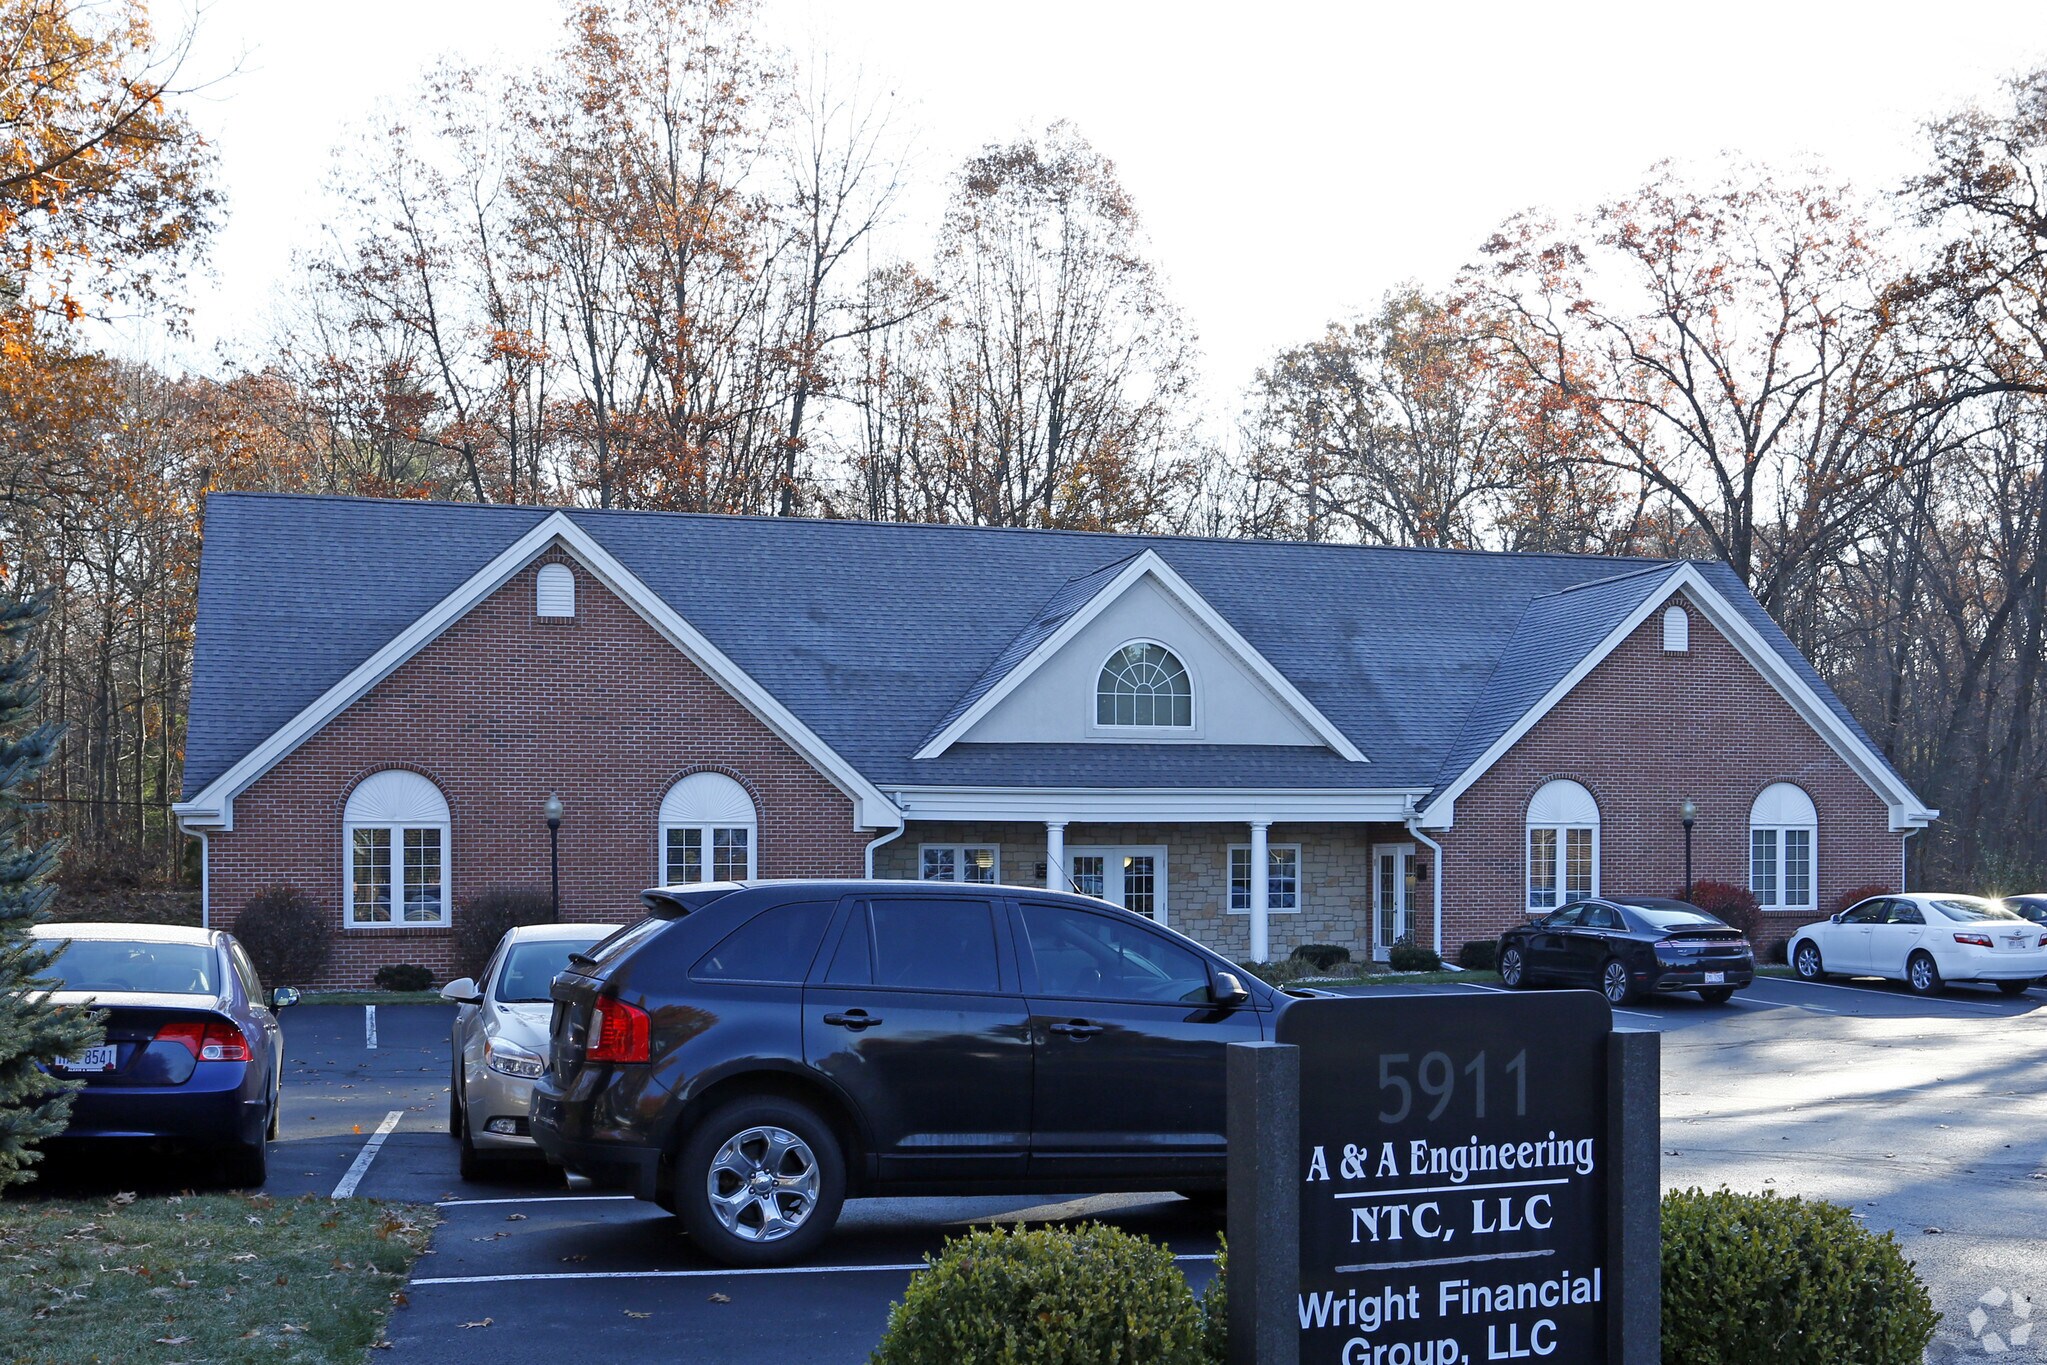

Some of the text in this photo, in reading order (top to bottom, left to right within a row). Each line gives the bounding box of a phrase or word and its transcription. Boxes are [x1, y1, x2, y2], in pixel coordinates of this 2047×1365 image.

[1378, 1049, 1527, 1124] 5911
[1305, 1130, 1594, 1184] A & A Engineering
[1350, 1193, 1554, 1243] NTC, LLC
[1298, 1267, 1601, 1333] Wright Financial
[1341, 1318, 1558, 1365] Group, LLC
